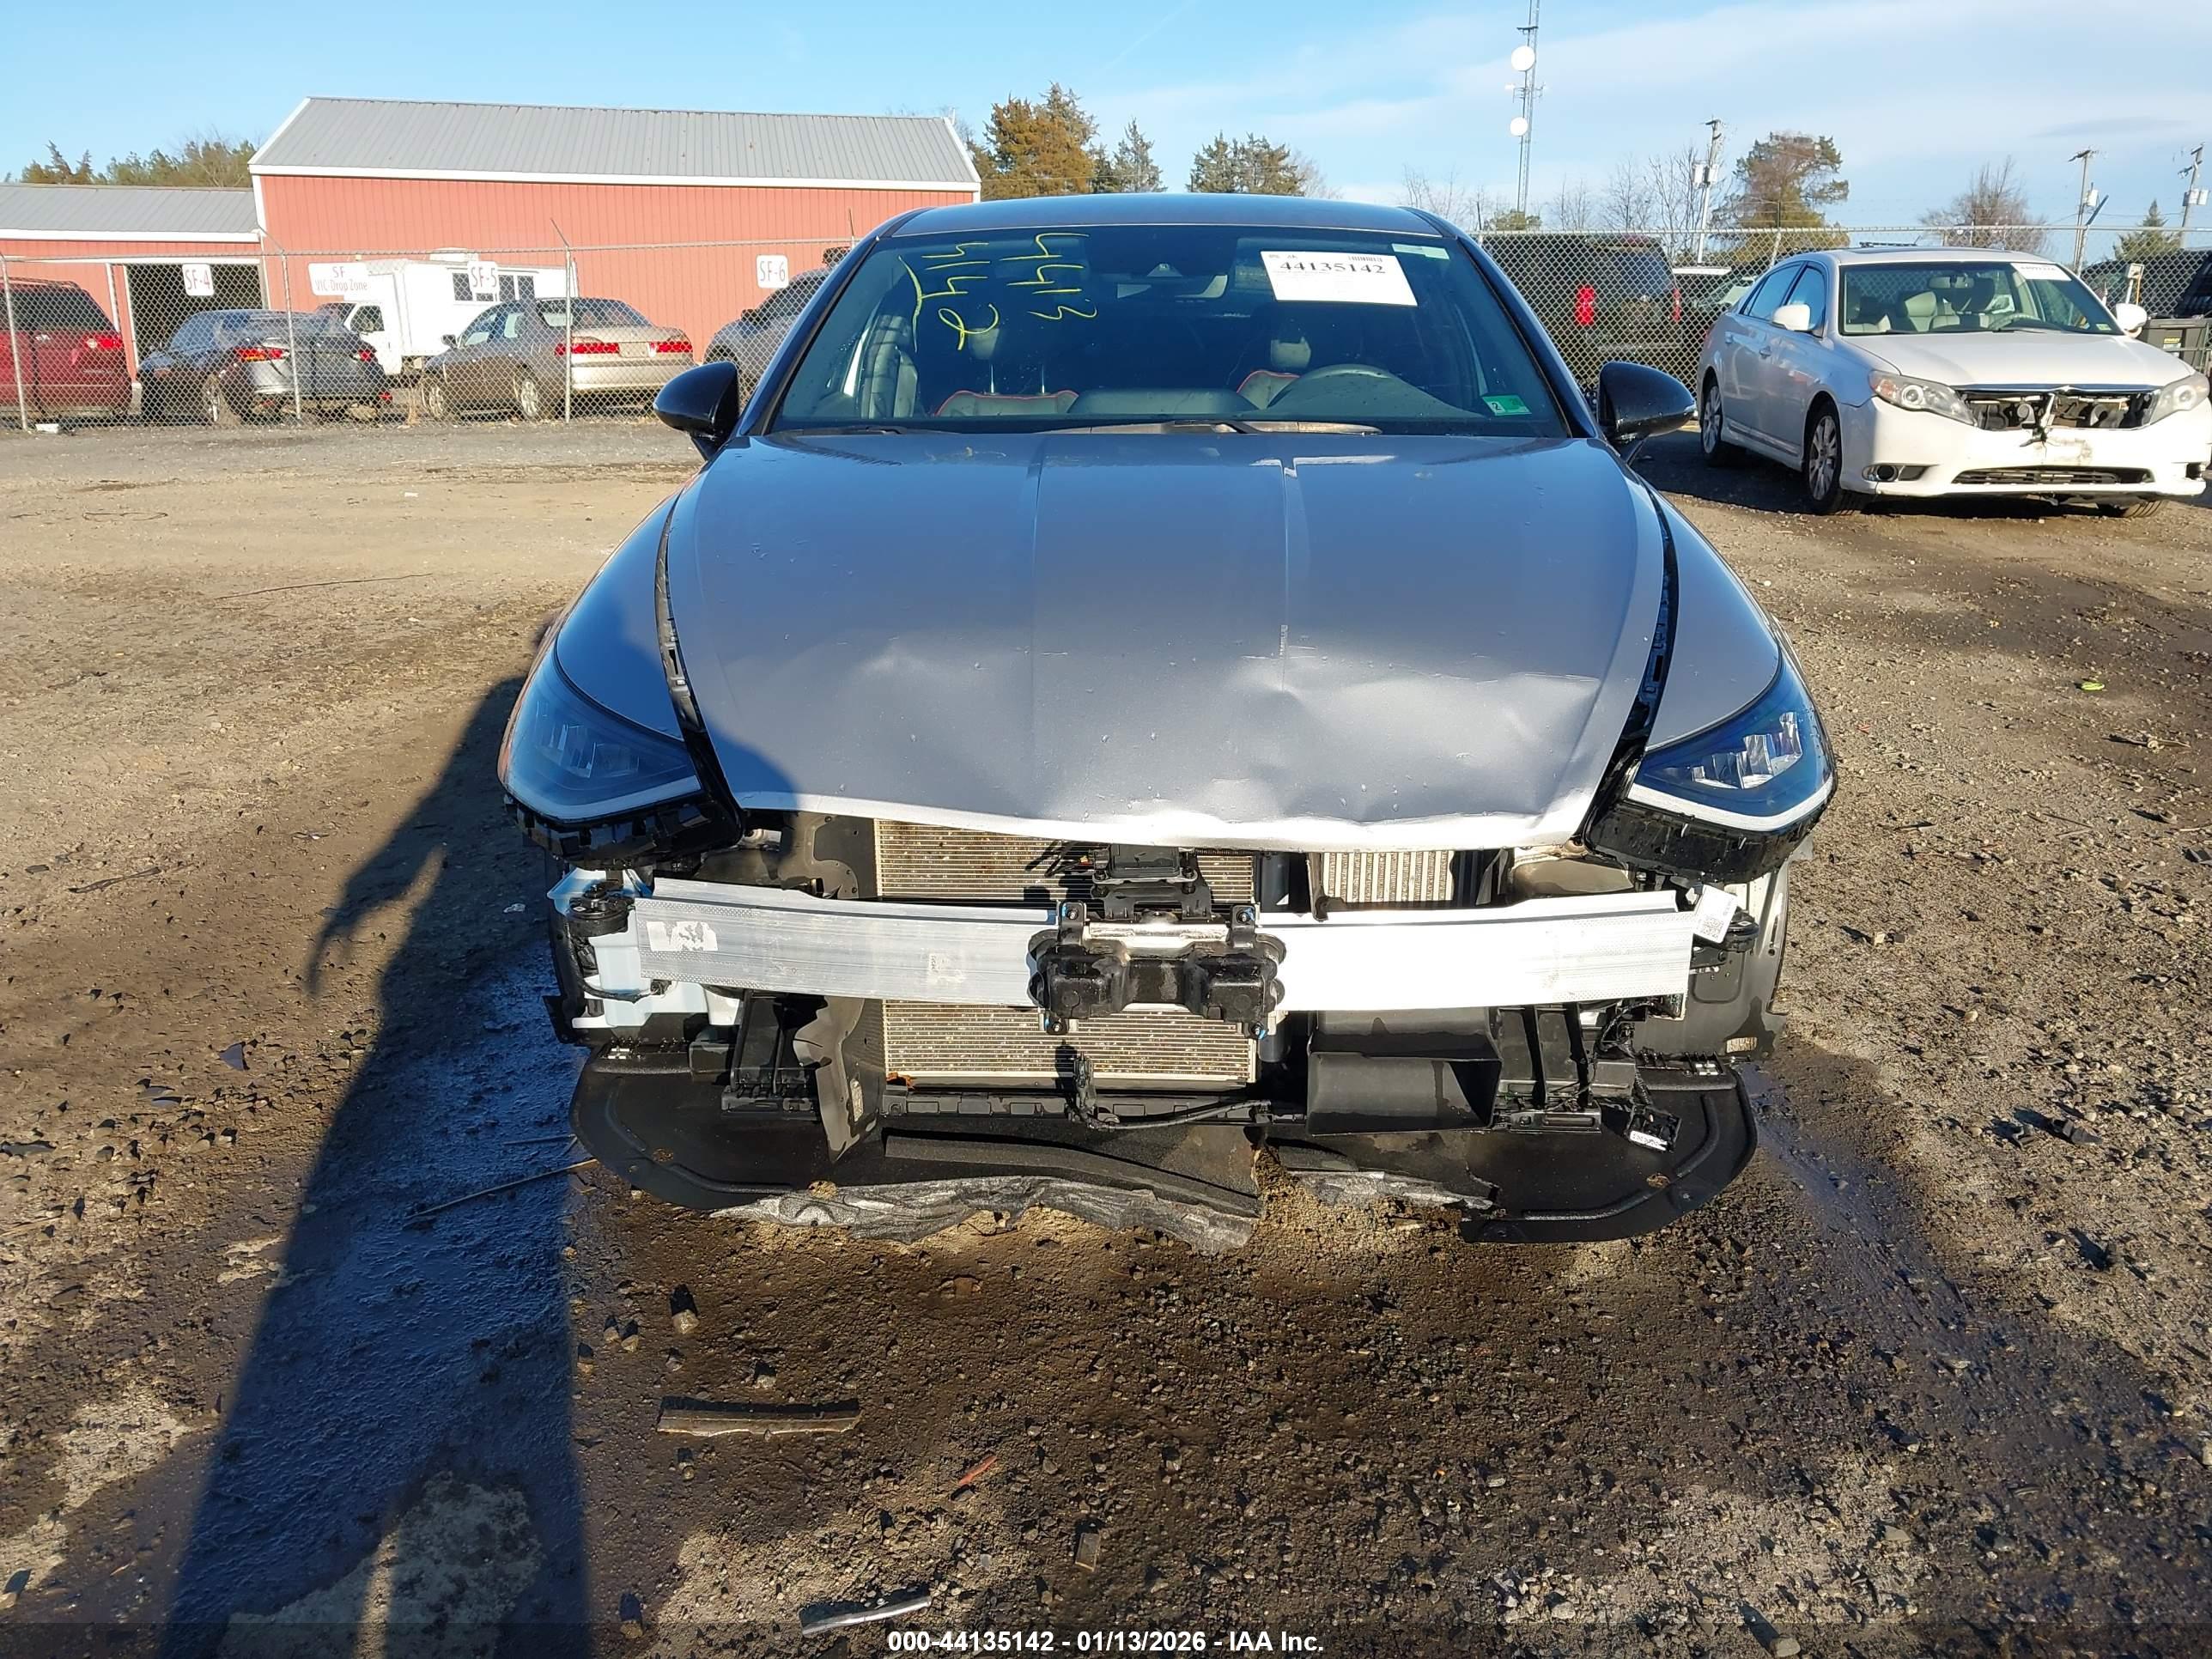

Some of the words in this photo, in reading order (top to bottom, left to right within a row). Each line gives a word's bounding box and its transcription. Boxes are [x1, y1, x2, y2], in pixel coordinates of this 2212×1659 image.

[332, 265, 345, 278] SF
[760, 260, 786, 282] SF-6
[1279, 261, 1387, 274] 44135142
[185, 269, 210, 289] SF-4
[471, 266, 497, 288] SF-5
[1000, 233, 1097, 320] 4413
[330, 279, 348, 293] Drop
[349, 278, 368, 291] Zone
[1492, 402, 1502, 410] 2
